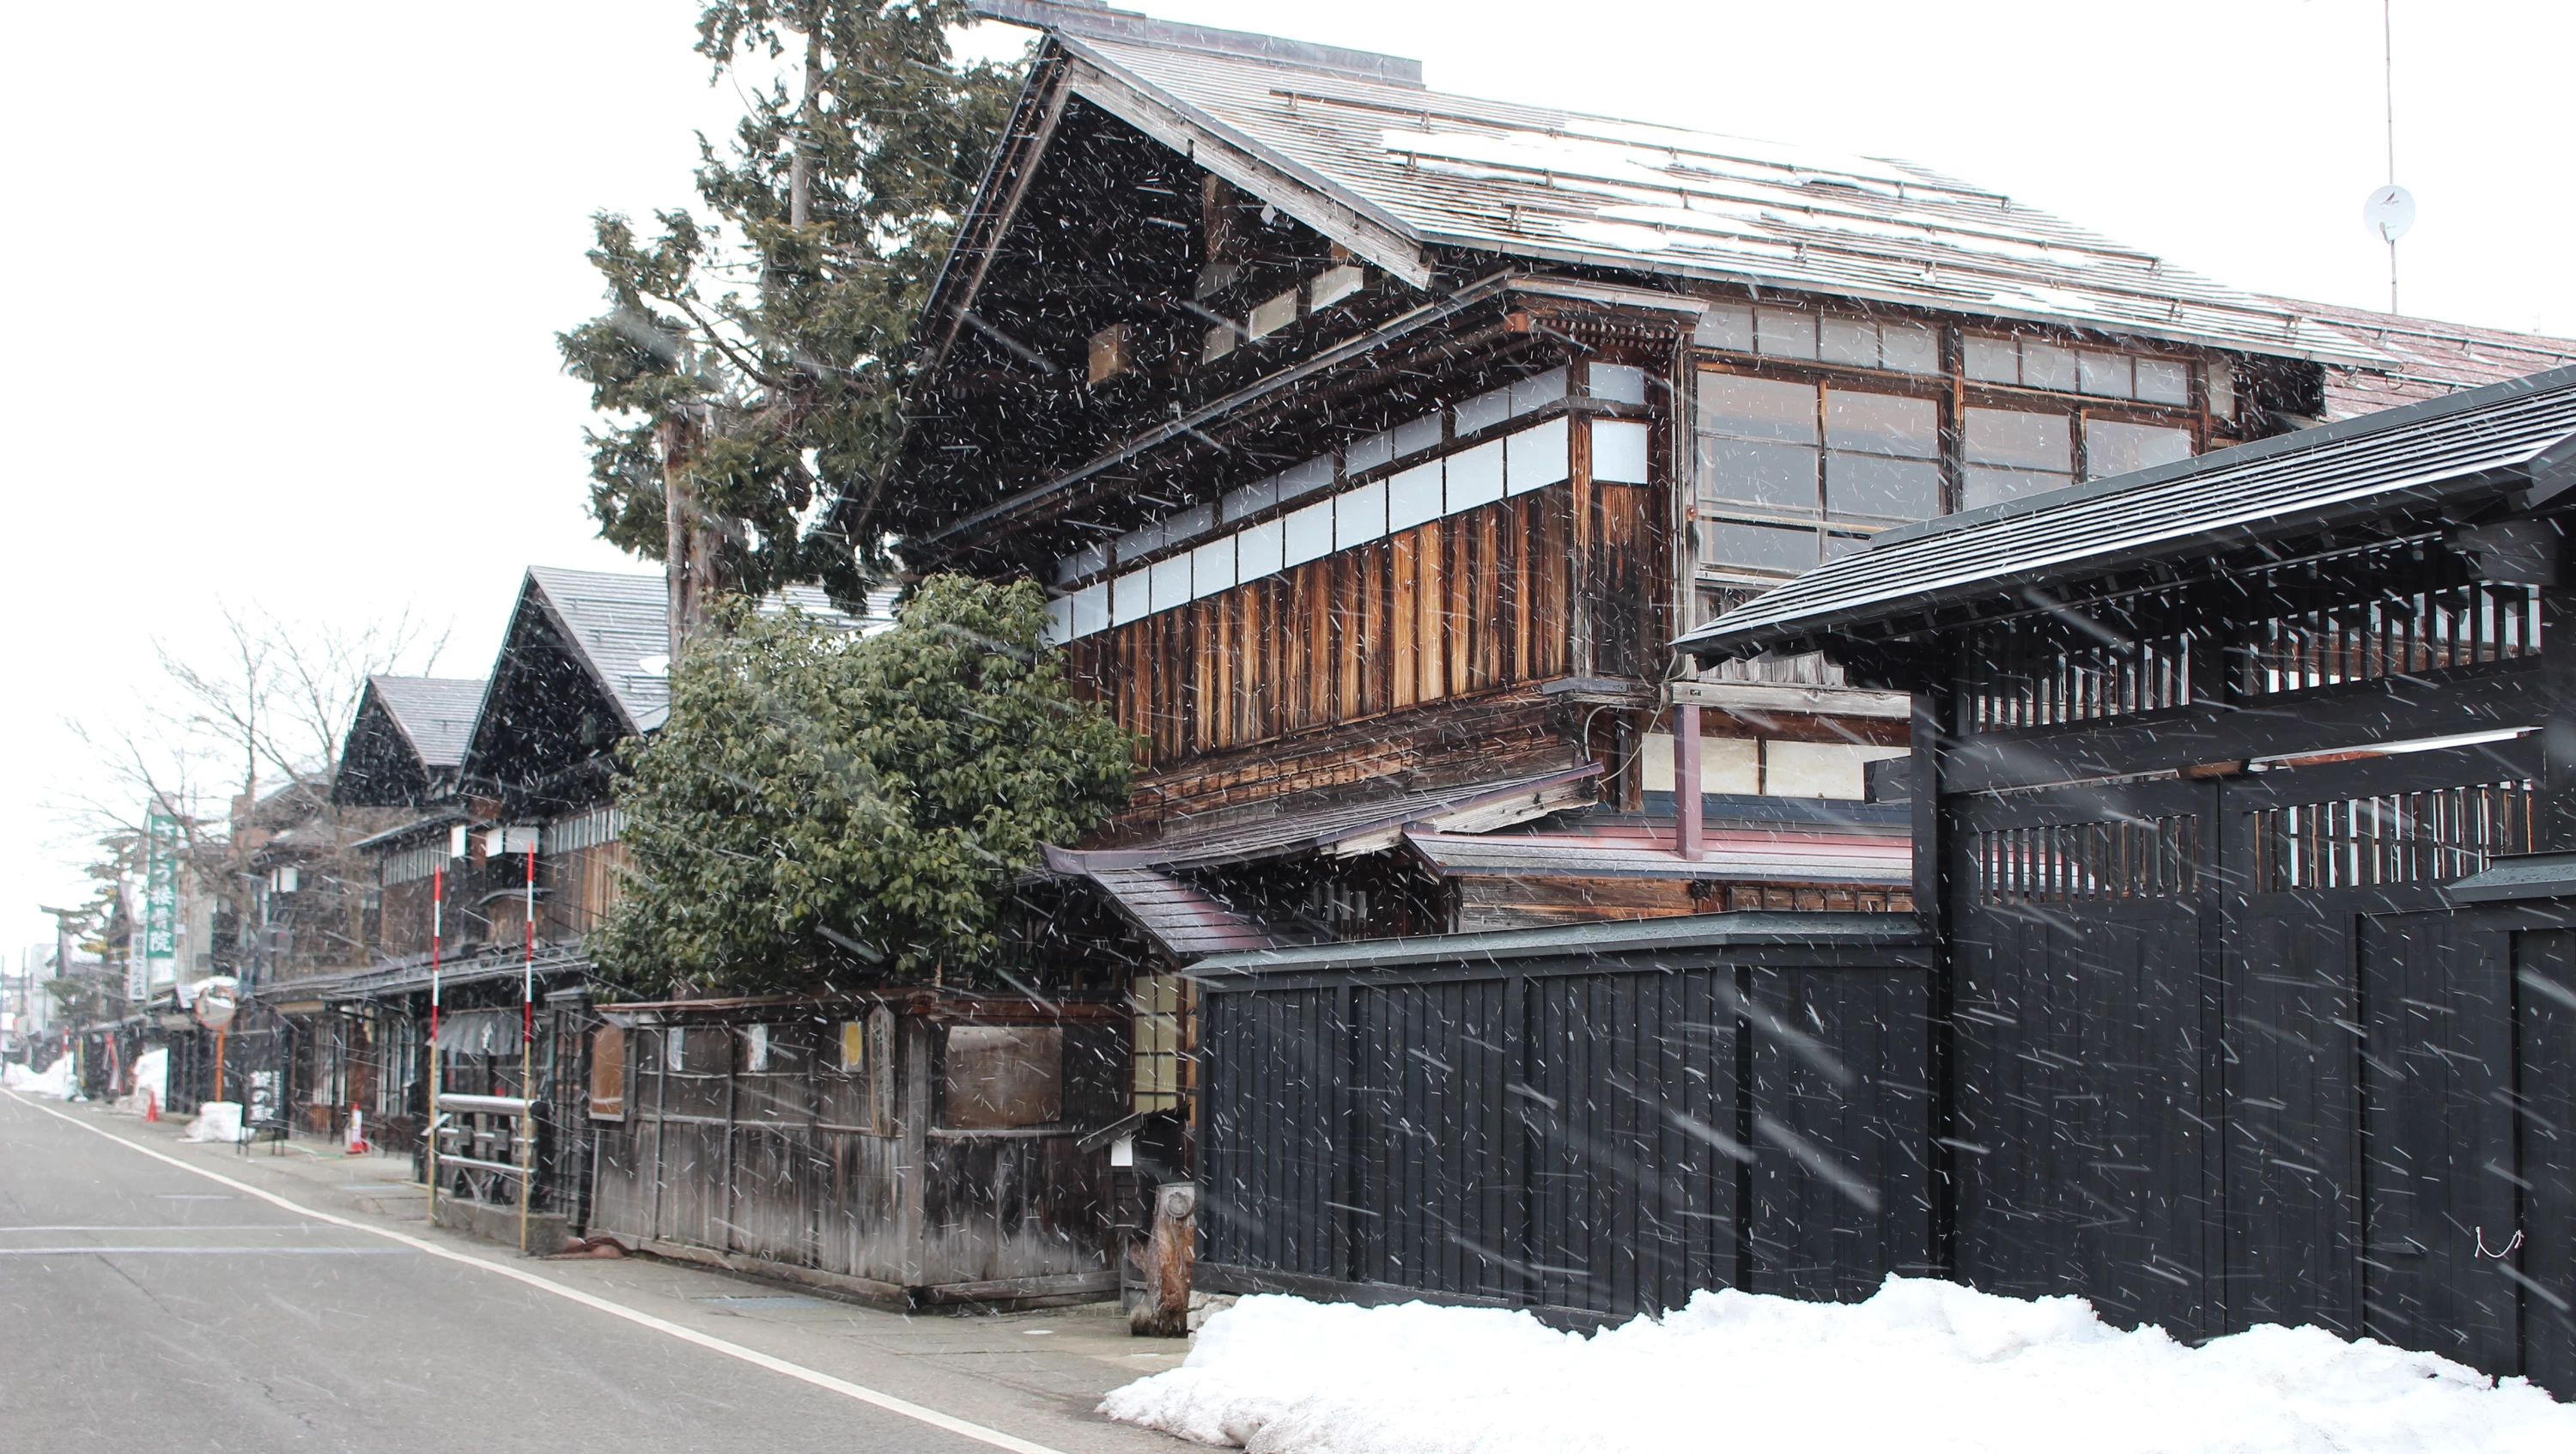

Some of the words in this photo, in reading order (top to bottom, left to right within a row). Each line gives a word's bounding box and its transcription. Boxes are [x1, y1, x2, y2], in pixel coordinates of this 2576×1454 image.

[149, 820, 175, 952] さとう接骨院
